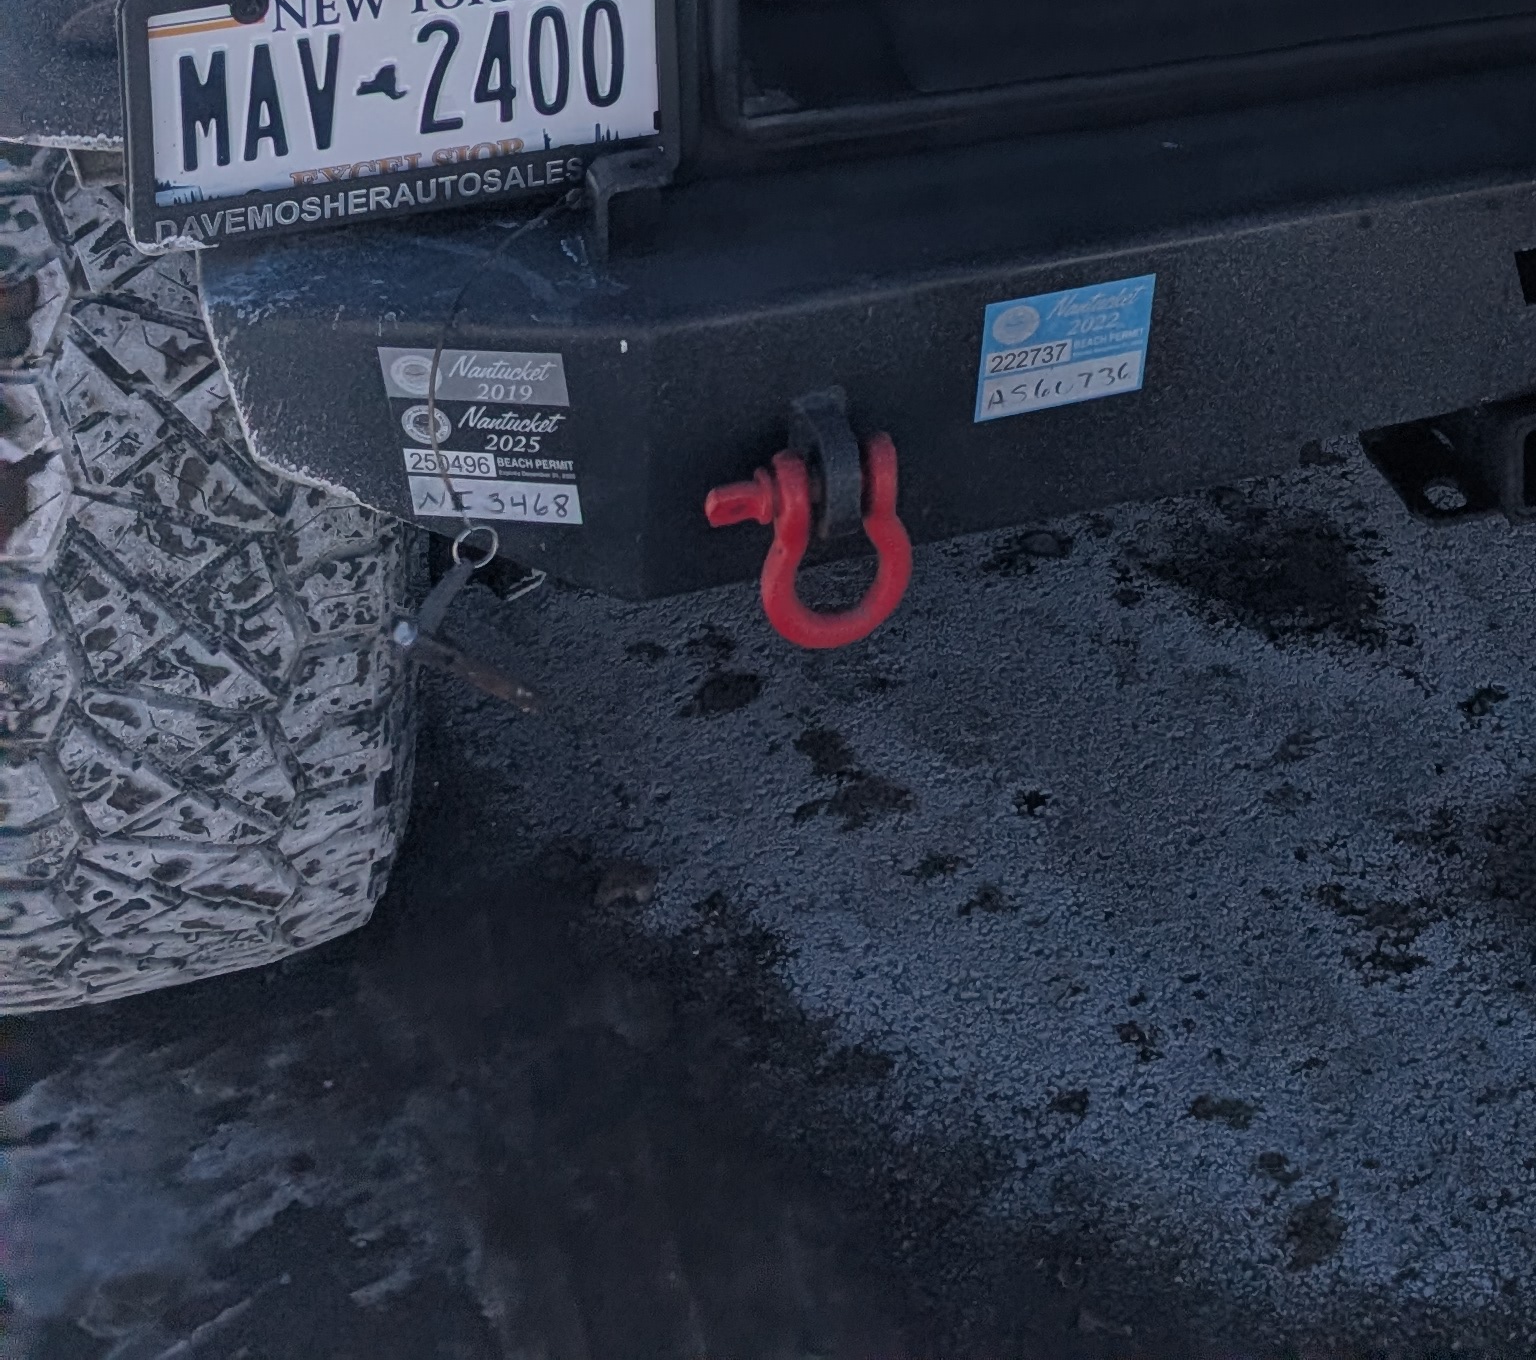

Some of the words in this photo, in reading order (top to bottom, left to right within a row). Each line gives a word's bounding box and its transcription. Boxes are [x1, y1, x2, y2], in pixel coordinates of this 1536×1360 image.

[179, 33, 340, 173] MAV
[1066, 312, 1120, 336] 2022
[449, 354, 557, 382] Nantucket
[989, 343, 1068, 374] 222737
[476, 383, 533, 401] 2019
[457, 406, 566, 433] Nantucket
[484, 434, 542, 453] 2025
[410, 452, 491, 475] 250496
[496, 457, 533, 469] BEACH
[534, 459, 574, 471] PERMIT
[488, 492, 571, 518] 3468
